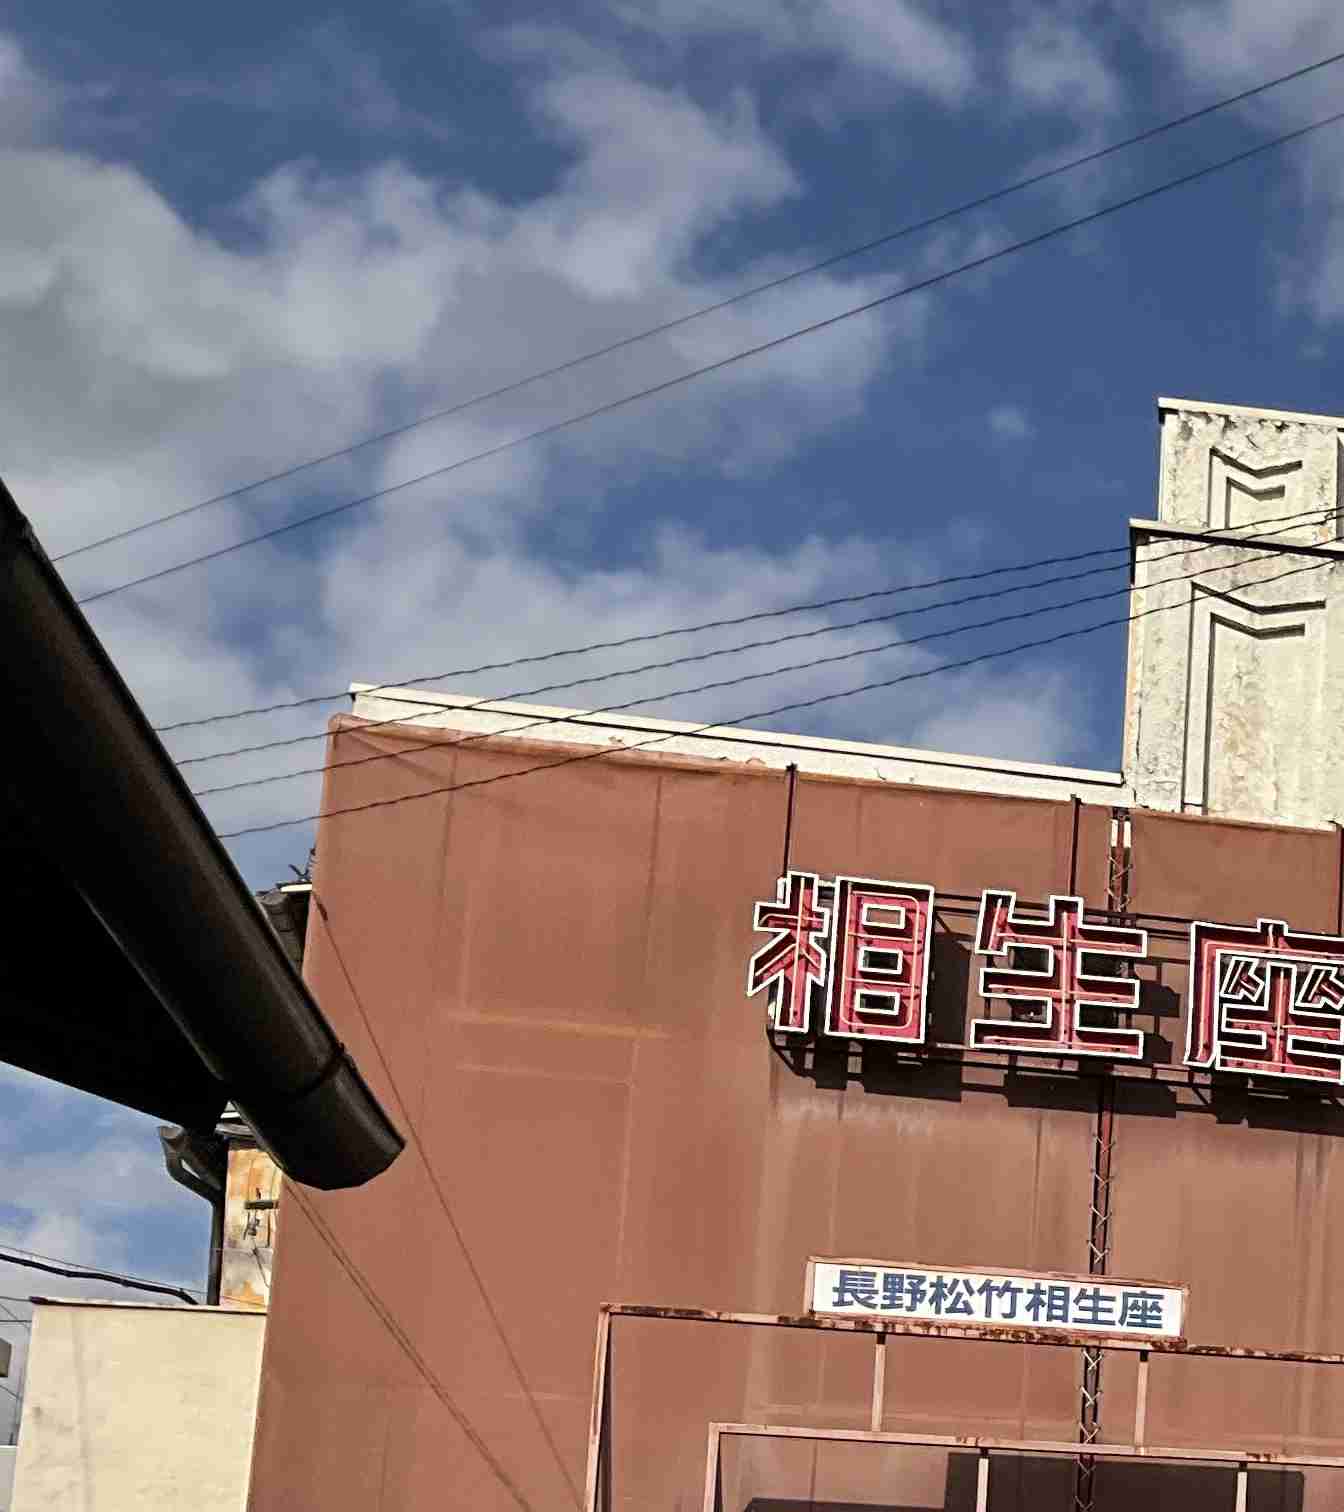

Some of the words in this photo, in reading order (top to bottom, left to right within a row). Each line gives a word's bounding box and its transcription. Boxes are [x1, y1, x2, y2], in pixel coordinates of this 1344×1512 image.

[832, 1268, 1164, 1330] 長野松竹相生座
